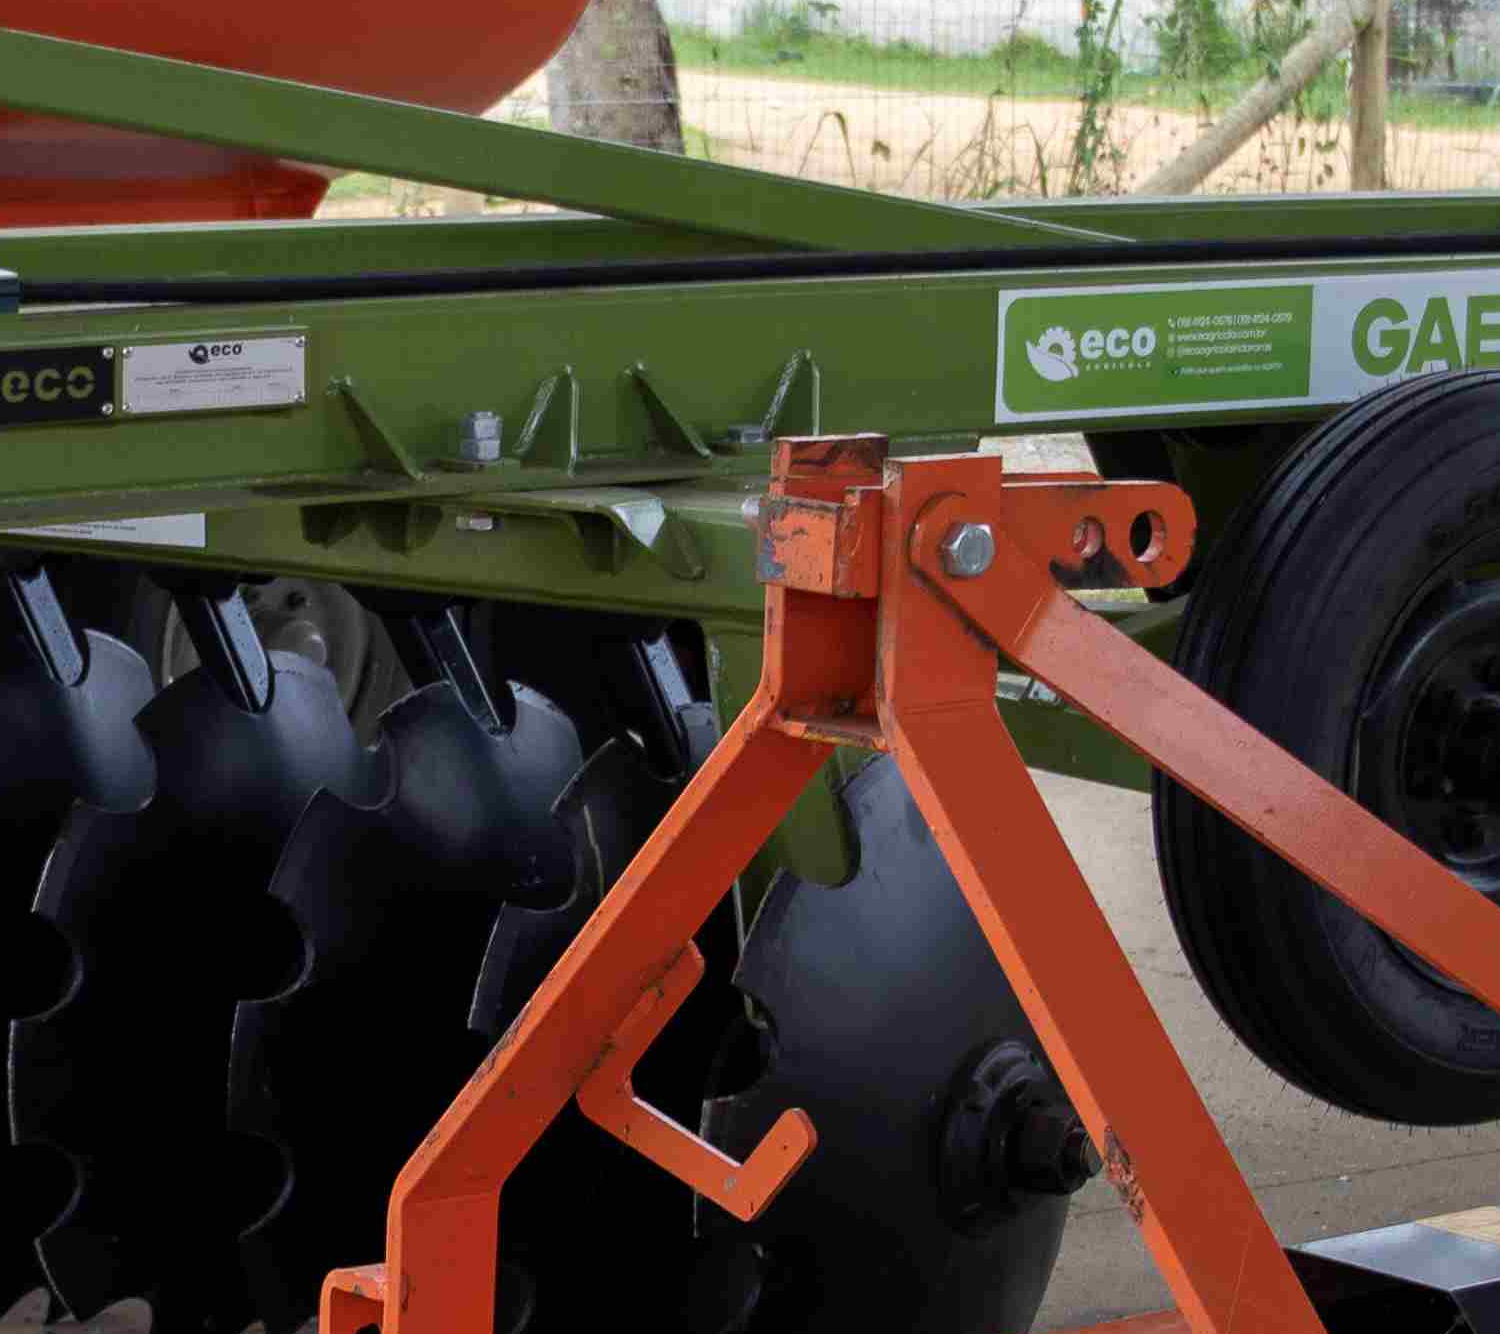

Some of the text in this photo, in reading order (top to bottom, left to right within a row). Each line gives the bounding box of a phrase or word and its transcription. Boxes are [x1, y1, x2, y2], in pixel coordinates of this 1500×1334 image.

[209, 343, 243, 357] eco
[1080, 325, 1157, 360] eco
[0, 365, 95, 404] eco
